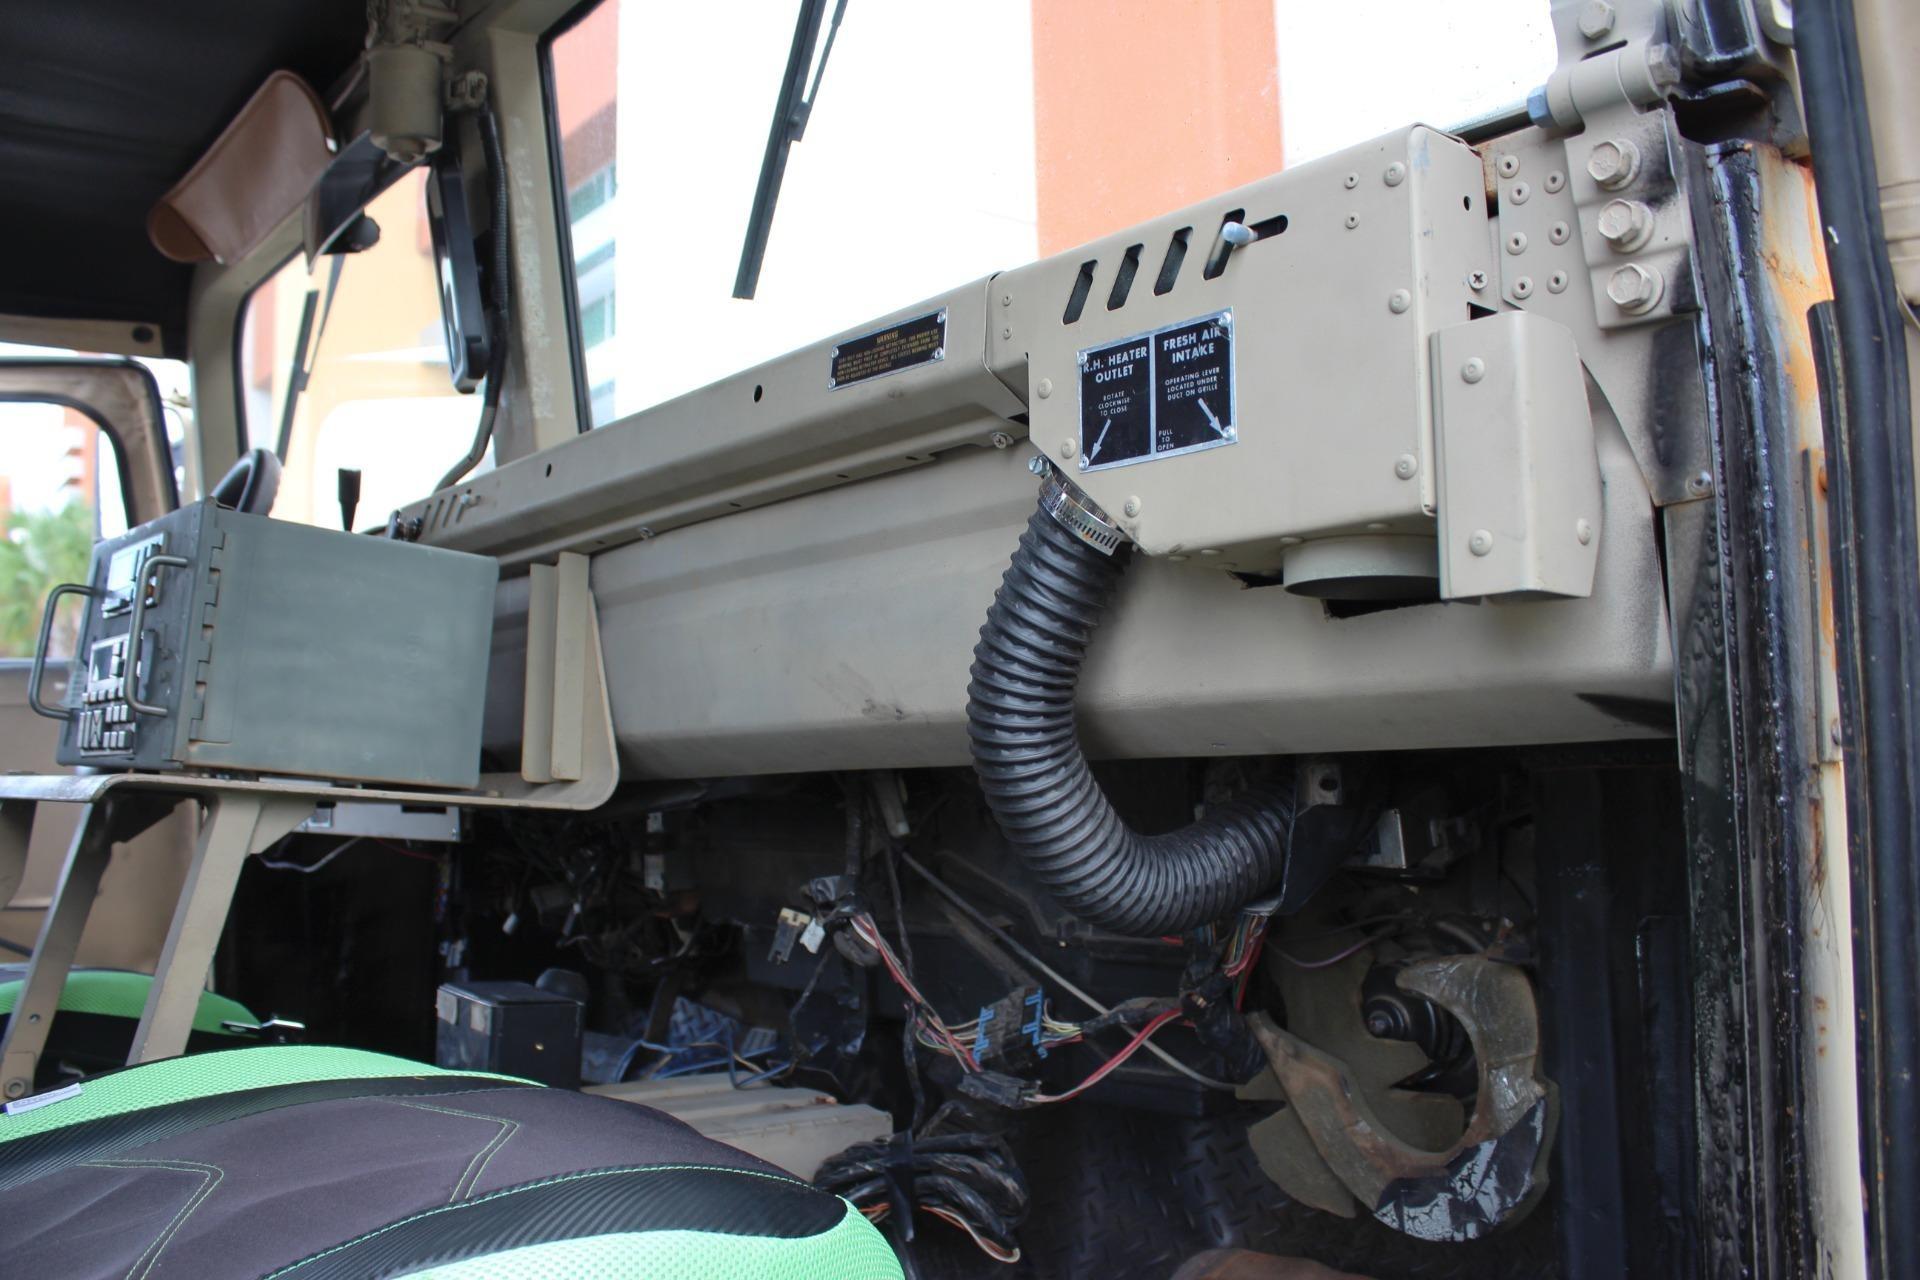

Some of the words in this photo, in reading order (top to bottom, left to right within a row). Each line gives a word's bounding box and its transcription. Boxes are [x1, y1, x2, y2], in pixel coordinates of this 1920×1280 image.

[1163, 332, 1197, 351] FRESH
[1201, 327, 1221, 340] AIR
[1083, 359, 1104, 374] R.H.
[1108, 346, 1148, 367] HEATER
[1172, 343, 1215, 364] INTAKE
[1095, 364, 1134, 383] OUTLET
[1165, 371, 1200, 386] OPERATING
[1201, 366, 1220, 376] LEVER
[1167, 381, 1195, 393] LOCATED
[1196, 375, 1218, 385] UNDER
[1167, 392, 1184, 401] DUCT
[1185, 389, 1196, 397] ON
[1197, 382, 1218, 394] GRILLE
[1098, 397, 1130, 410] CLOCKWISE
[1103, 390, 1125, 401] ROTATE
[1100, 409, 1108, 417] TO
[1110, 405, 1128, 415] CLOSE
[1158, 429, 1173, 437] PULL
[1157, 443, 1174, 452] OPEN
